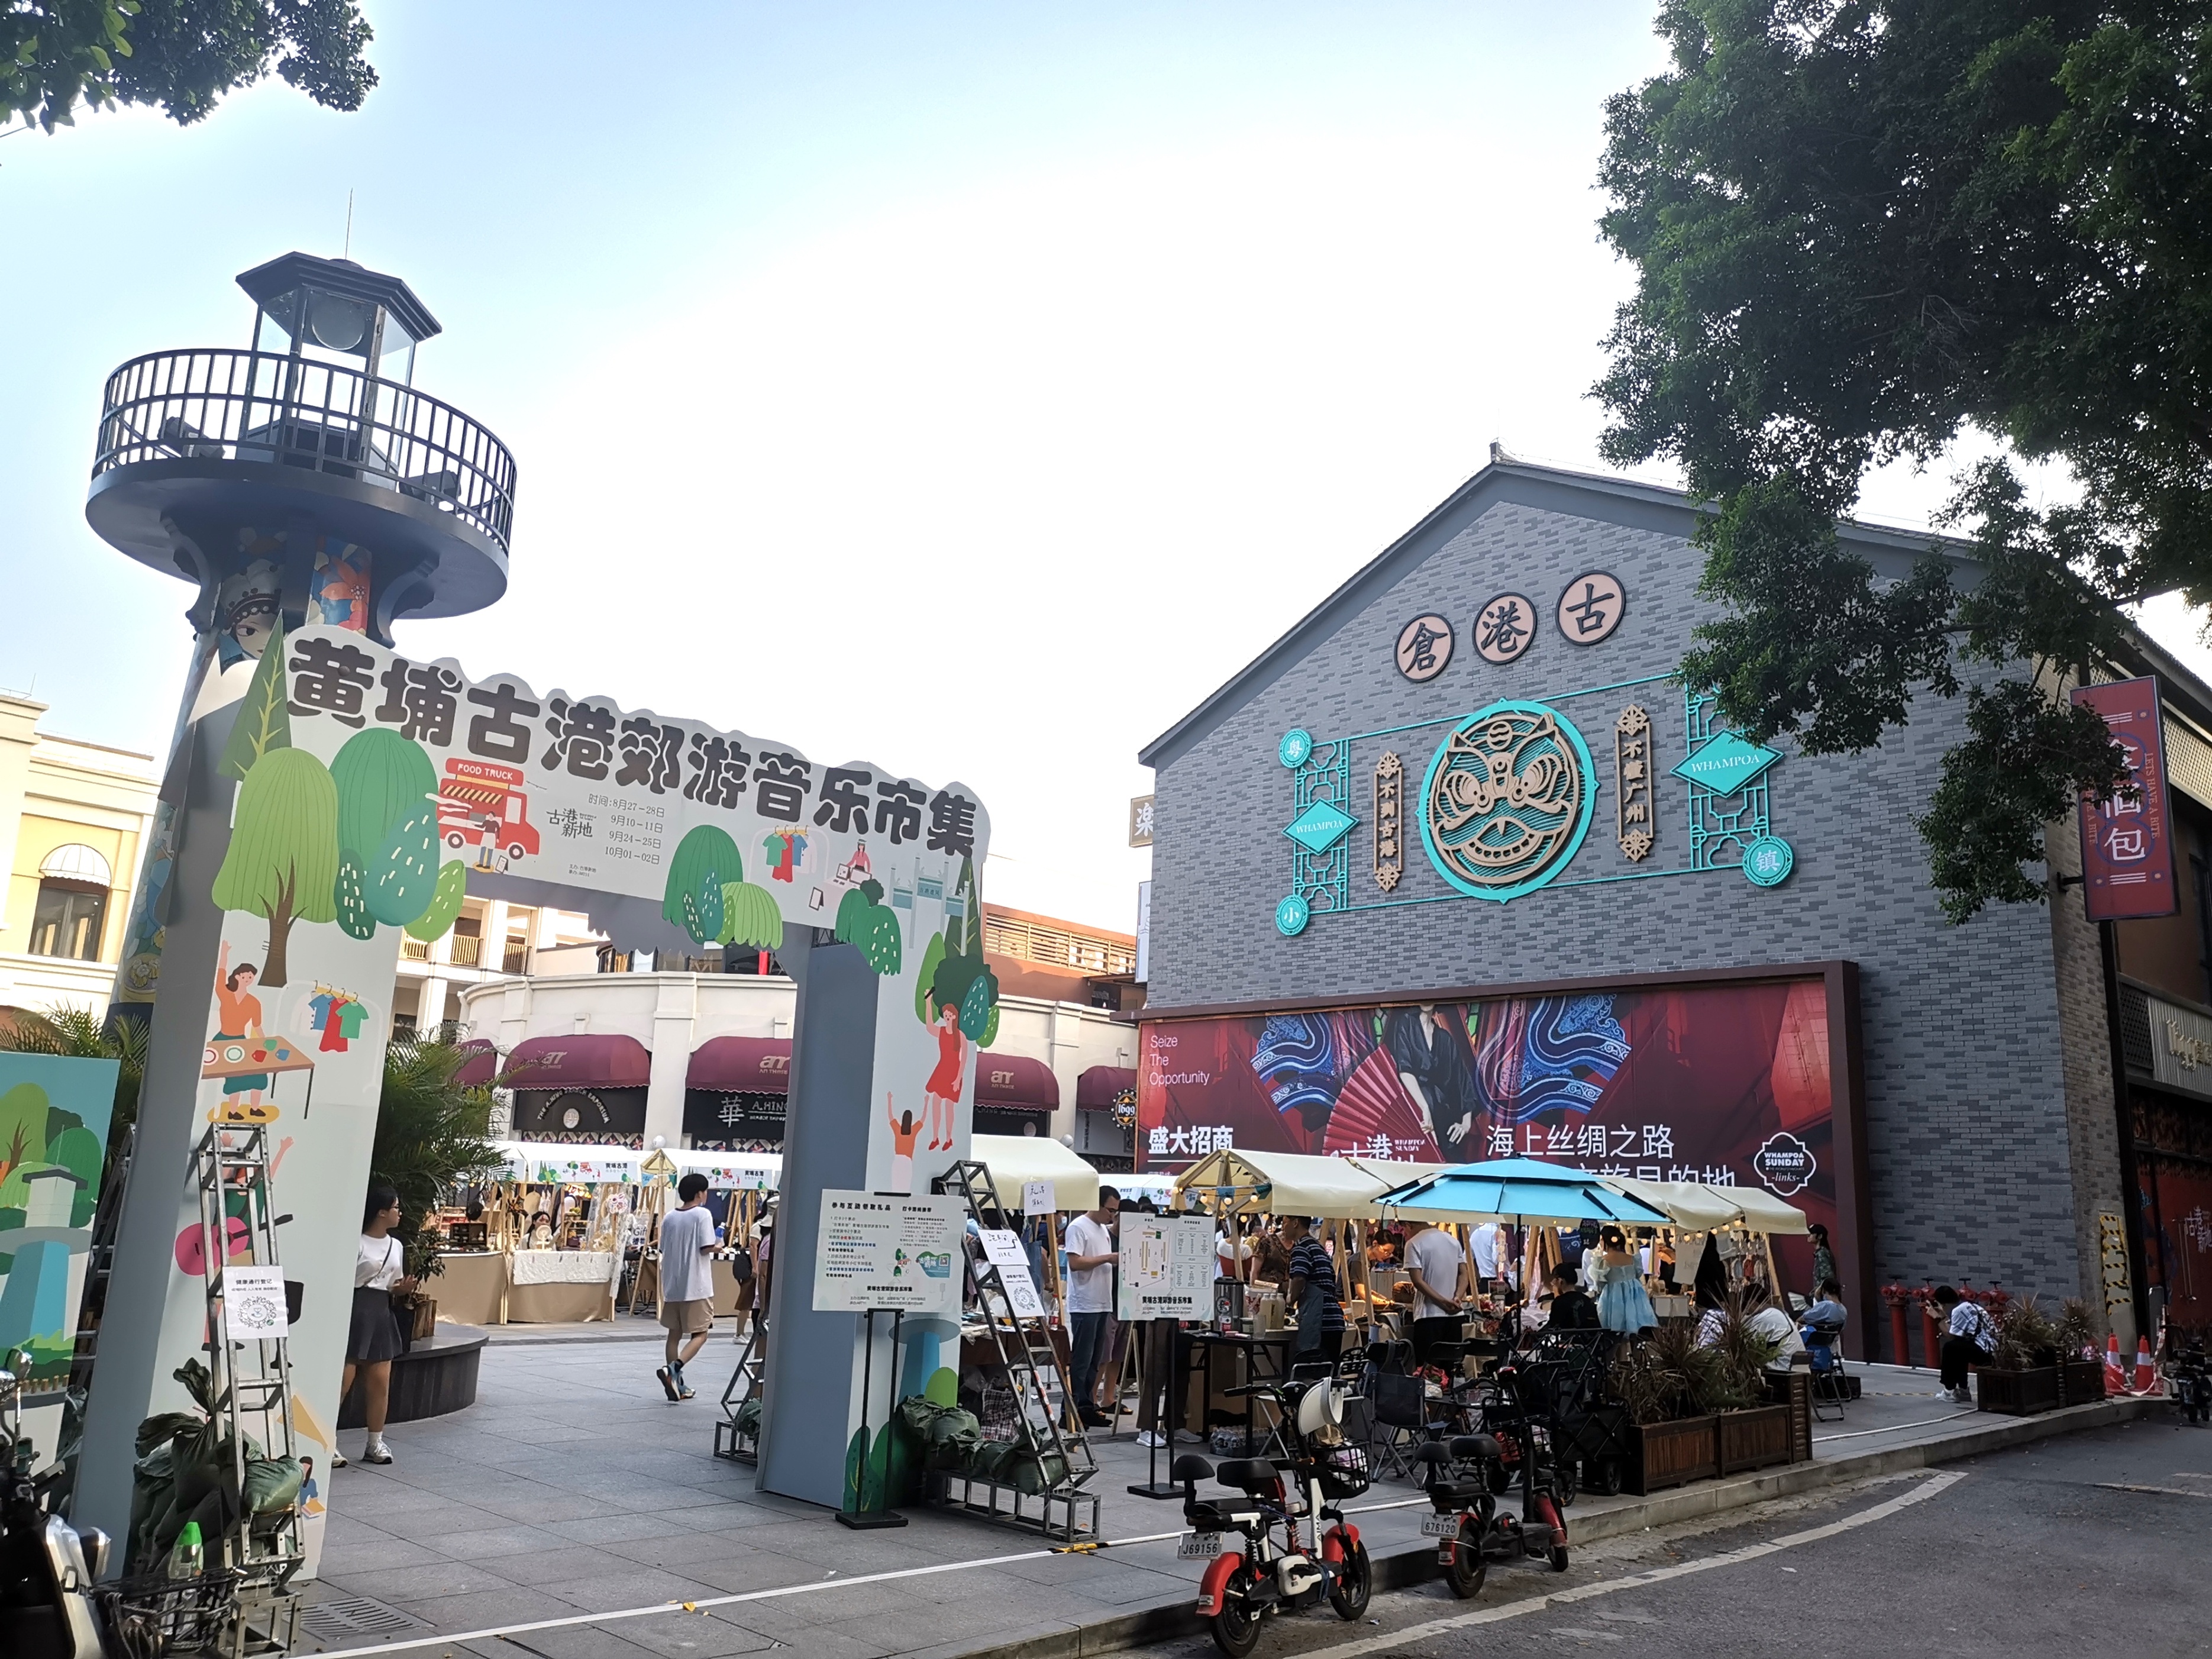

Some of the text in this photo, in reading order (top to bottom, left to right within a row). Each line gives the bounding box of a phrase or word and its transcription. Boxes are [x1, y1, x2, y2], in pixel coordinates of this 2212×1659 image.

[286, 638, 977, 858] 黄埔古港郊游音乐市集
[1287, 738, 1303, 758] 粤
[457, 763, 514, 781] FOOD TRUCK
[1691, 754, 1761, 773] WHAMPOA
[2147, 777, 2158, 805] HAVE
[546, 808, 578, 825] 古港
[611, 815, 663, 833] 9月10-11日
[1378, 782, 1397, 858] 不到古港
[560, 822, 593, 839] 新地
[1296, 819, 1344, 834] WHAMPOA
[2150, 816, 2161, 840] BITE
[609, 831, 661, 849] 9月24-25日
[605, 846, 660, 865] 10月01-02日
[1755, 849, 1781, 872] 镇
[1284, 906, 1300, 924] 小
[1150, 1035, 1178, 1048] Seize
[1149, 1054, 1169, 1066] The
[1149, 1070, 1210, 1087] Opportunity
[718, 1095, 745, 1128] 華
[1118, 1103, 1135, 1116] 1699
[1148, 1125, 1233, 1154] 盛大招商
[1486, 1124, 1675, 1159] 海上丝绸之路
[1765, 1158, 1804, 1167] SUNDAY
[1425, 1522, 1455, 1534] 676120
[1183, 1542, 1218, 1555] J69156
